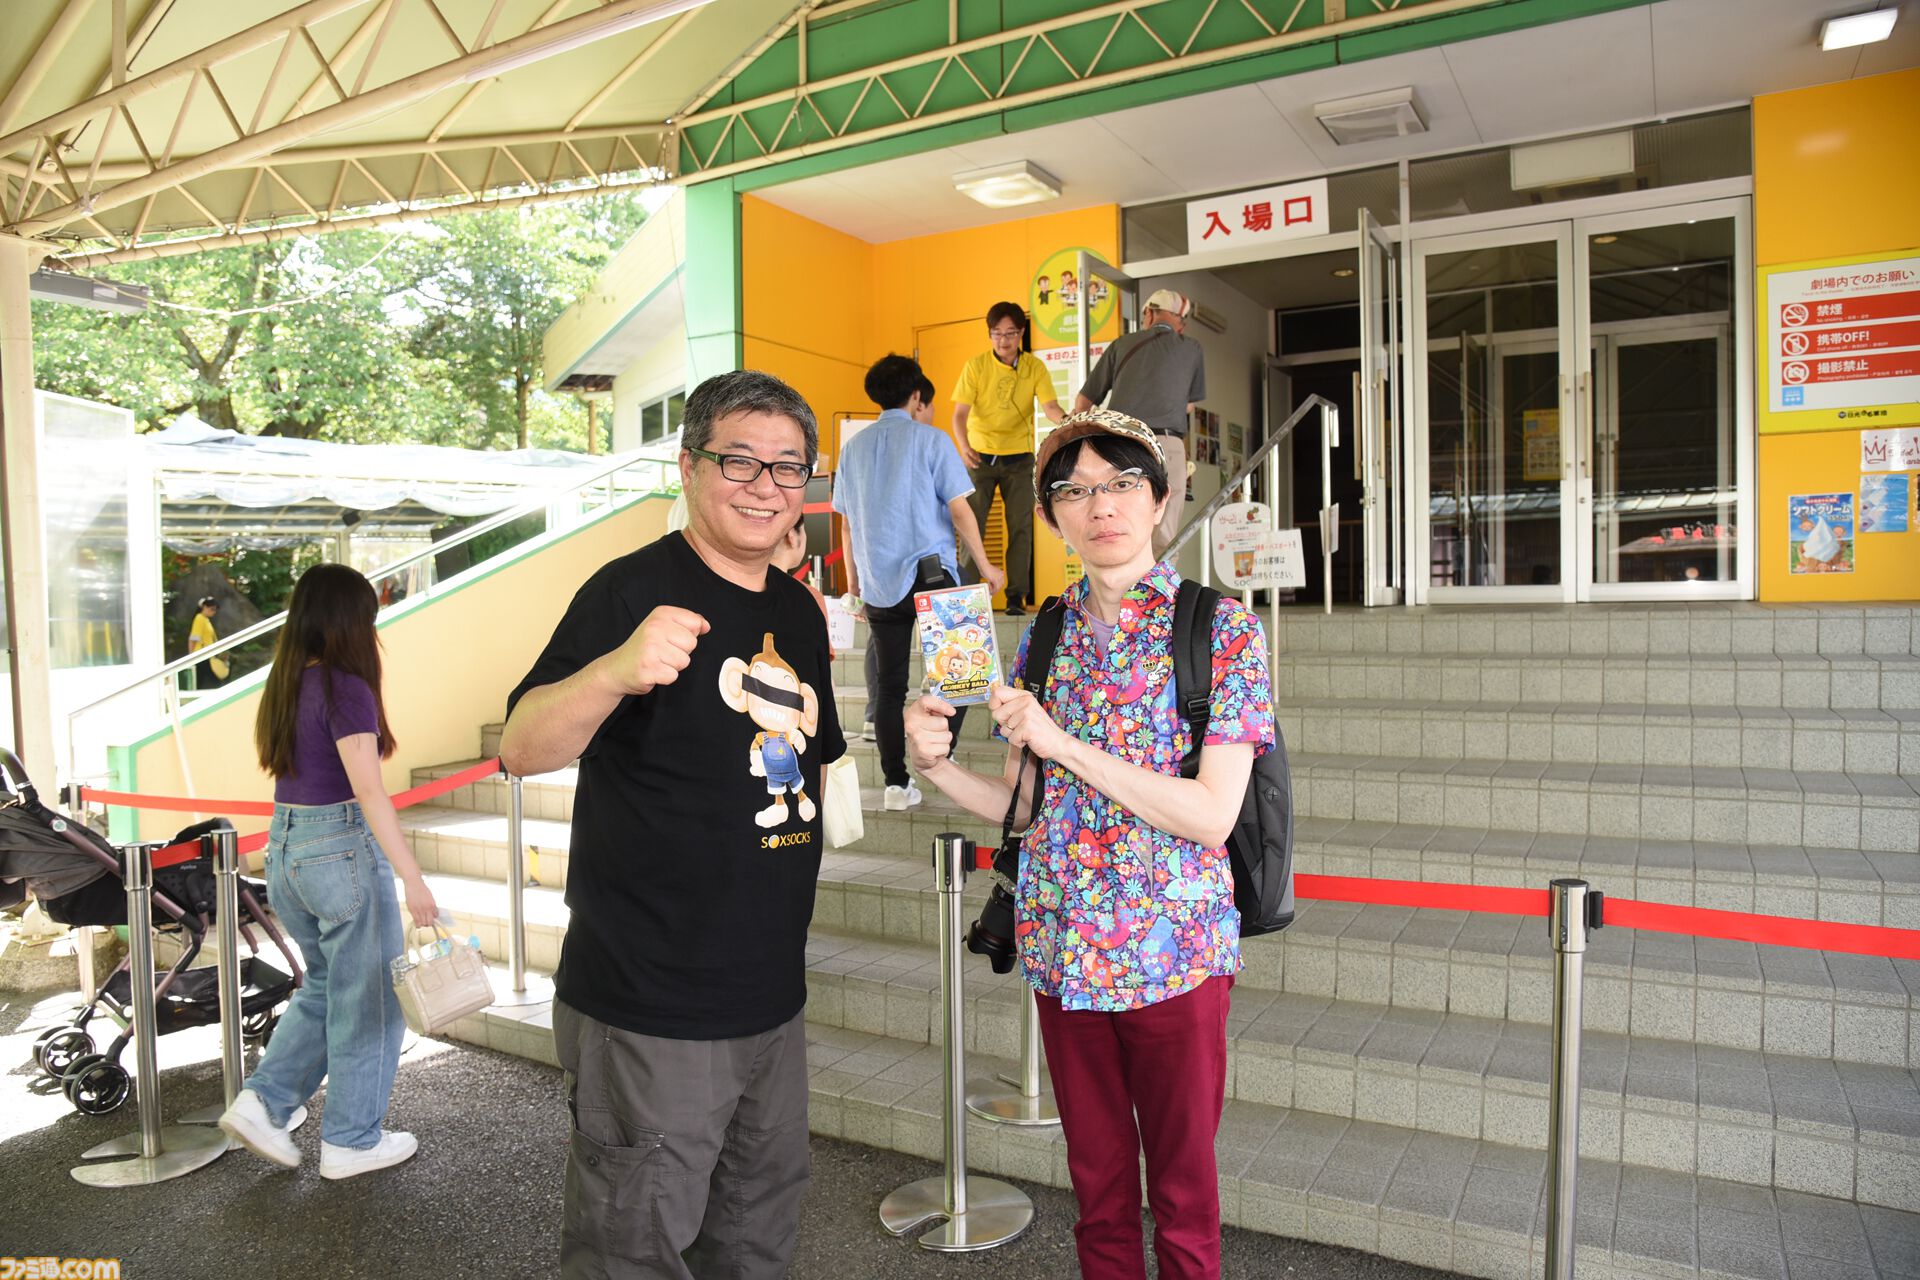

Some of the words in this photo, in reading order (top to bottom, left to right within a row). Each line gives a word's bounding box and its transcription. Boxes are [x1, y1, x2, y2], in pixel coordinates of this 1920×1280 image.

[1202, 196, 1313, 240] 入場口
[1811, 269, 1915, 290] 劇場内でのお願い
[1816, 303, 1843, 317] 禁煙
[1817, 331, 1870, 346] 携帯OFF!
[1817, 359, 1870, 374] 撮影禁止
[1791, 504, 1851, 516] ソフトクリーム
